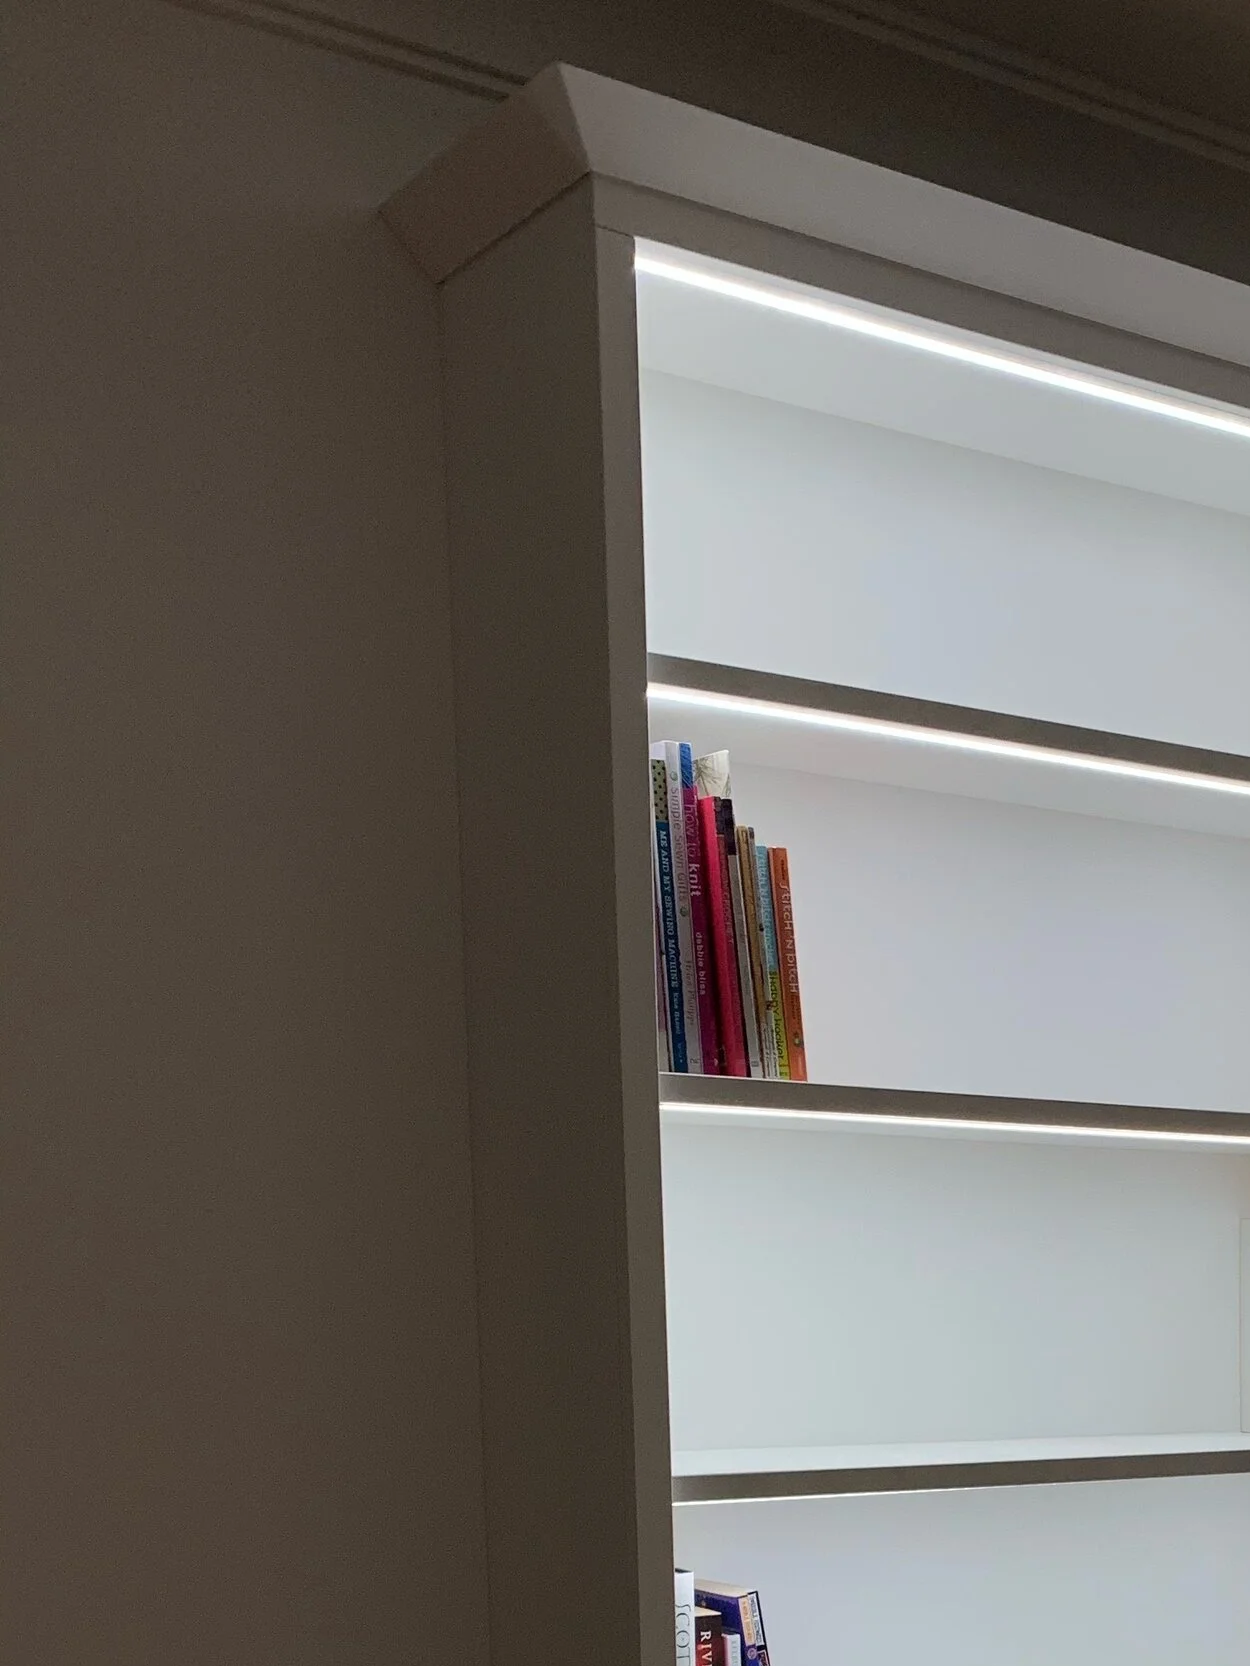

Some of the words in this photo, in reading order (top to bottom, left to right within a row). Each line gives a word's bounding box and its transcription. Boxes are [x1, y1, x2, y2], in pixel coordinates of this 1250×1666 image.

[659, 830, 668, 847] ME
[661, 849, 670, 873] AND
[663, 875, 671, 893] MY
[688, 863, 702, 897] knit
[664, 895, 675, 936] SEWING
[668, 938, 679, 988] MACHINE
[695, 932, 704, 967] debbie
[698, 970, 706, 995] bliss
